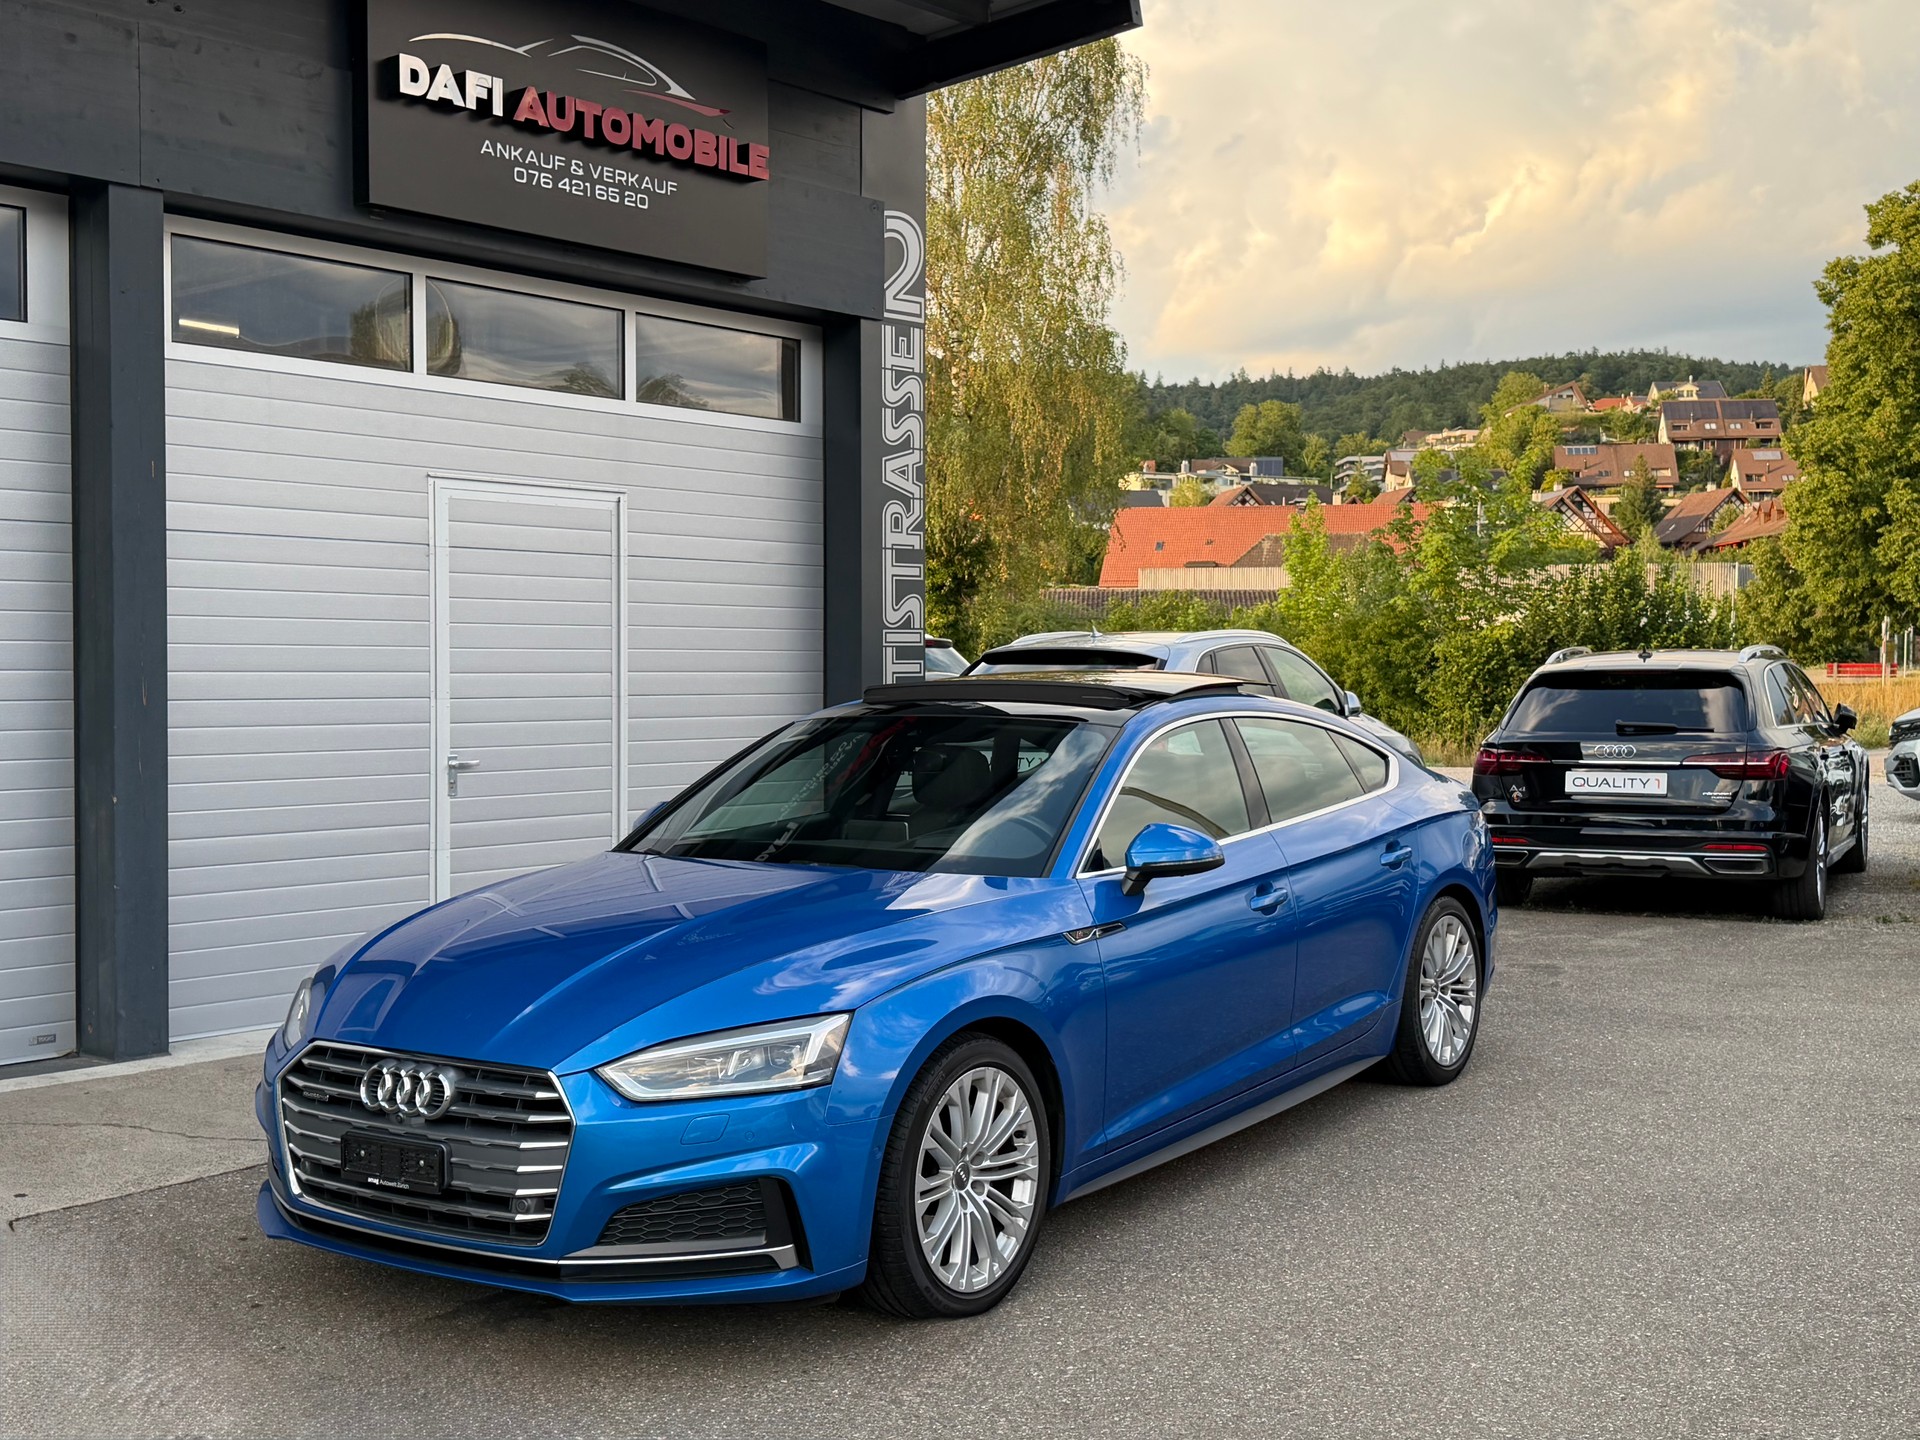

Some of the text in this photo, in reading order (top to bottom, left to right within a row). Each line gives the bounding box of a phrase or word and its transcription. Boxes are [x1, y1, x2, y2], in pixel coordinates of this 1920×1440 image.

[399, 53, 770, 181] DAFI AUTOMOBILE
[480, 140, 678, 196] ANKAUF & VERKAUF
[514, 167, 648, 209] 076 421 65 20
[1572, 777, 1661, 789] QUALITY 1
